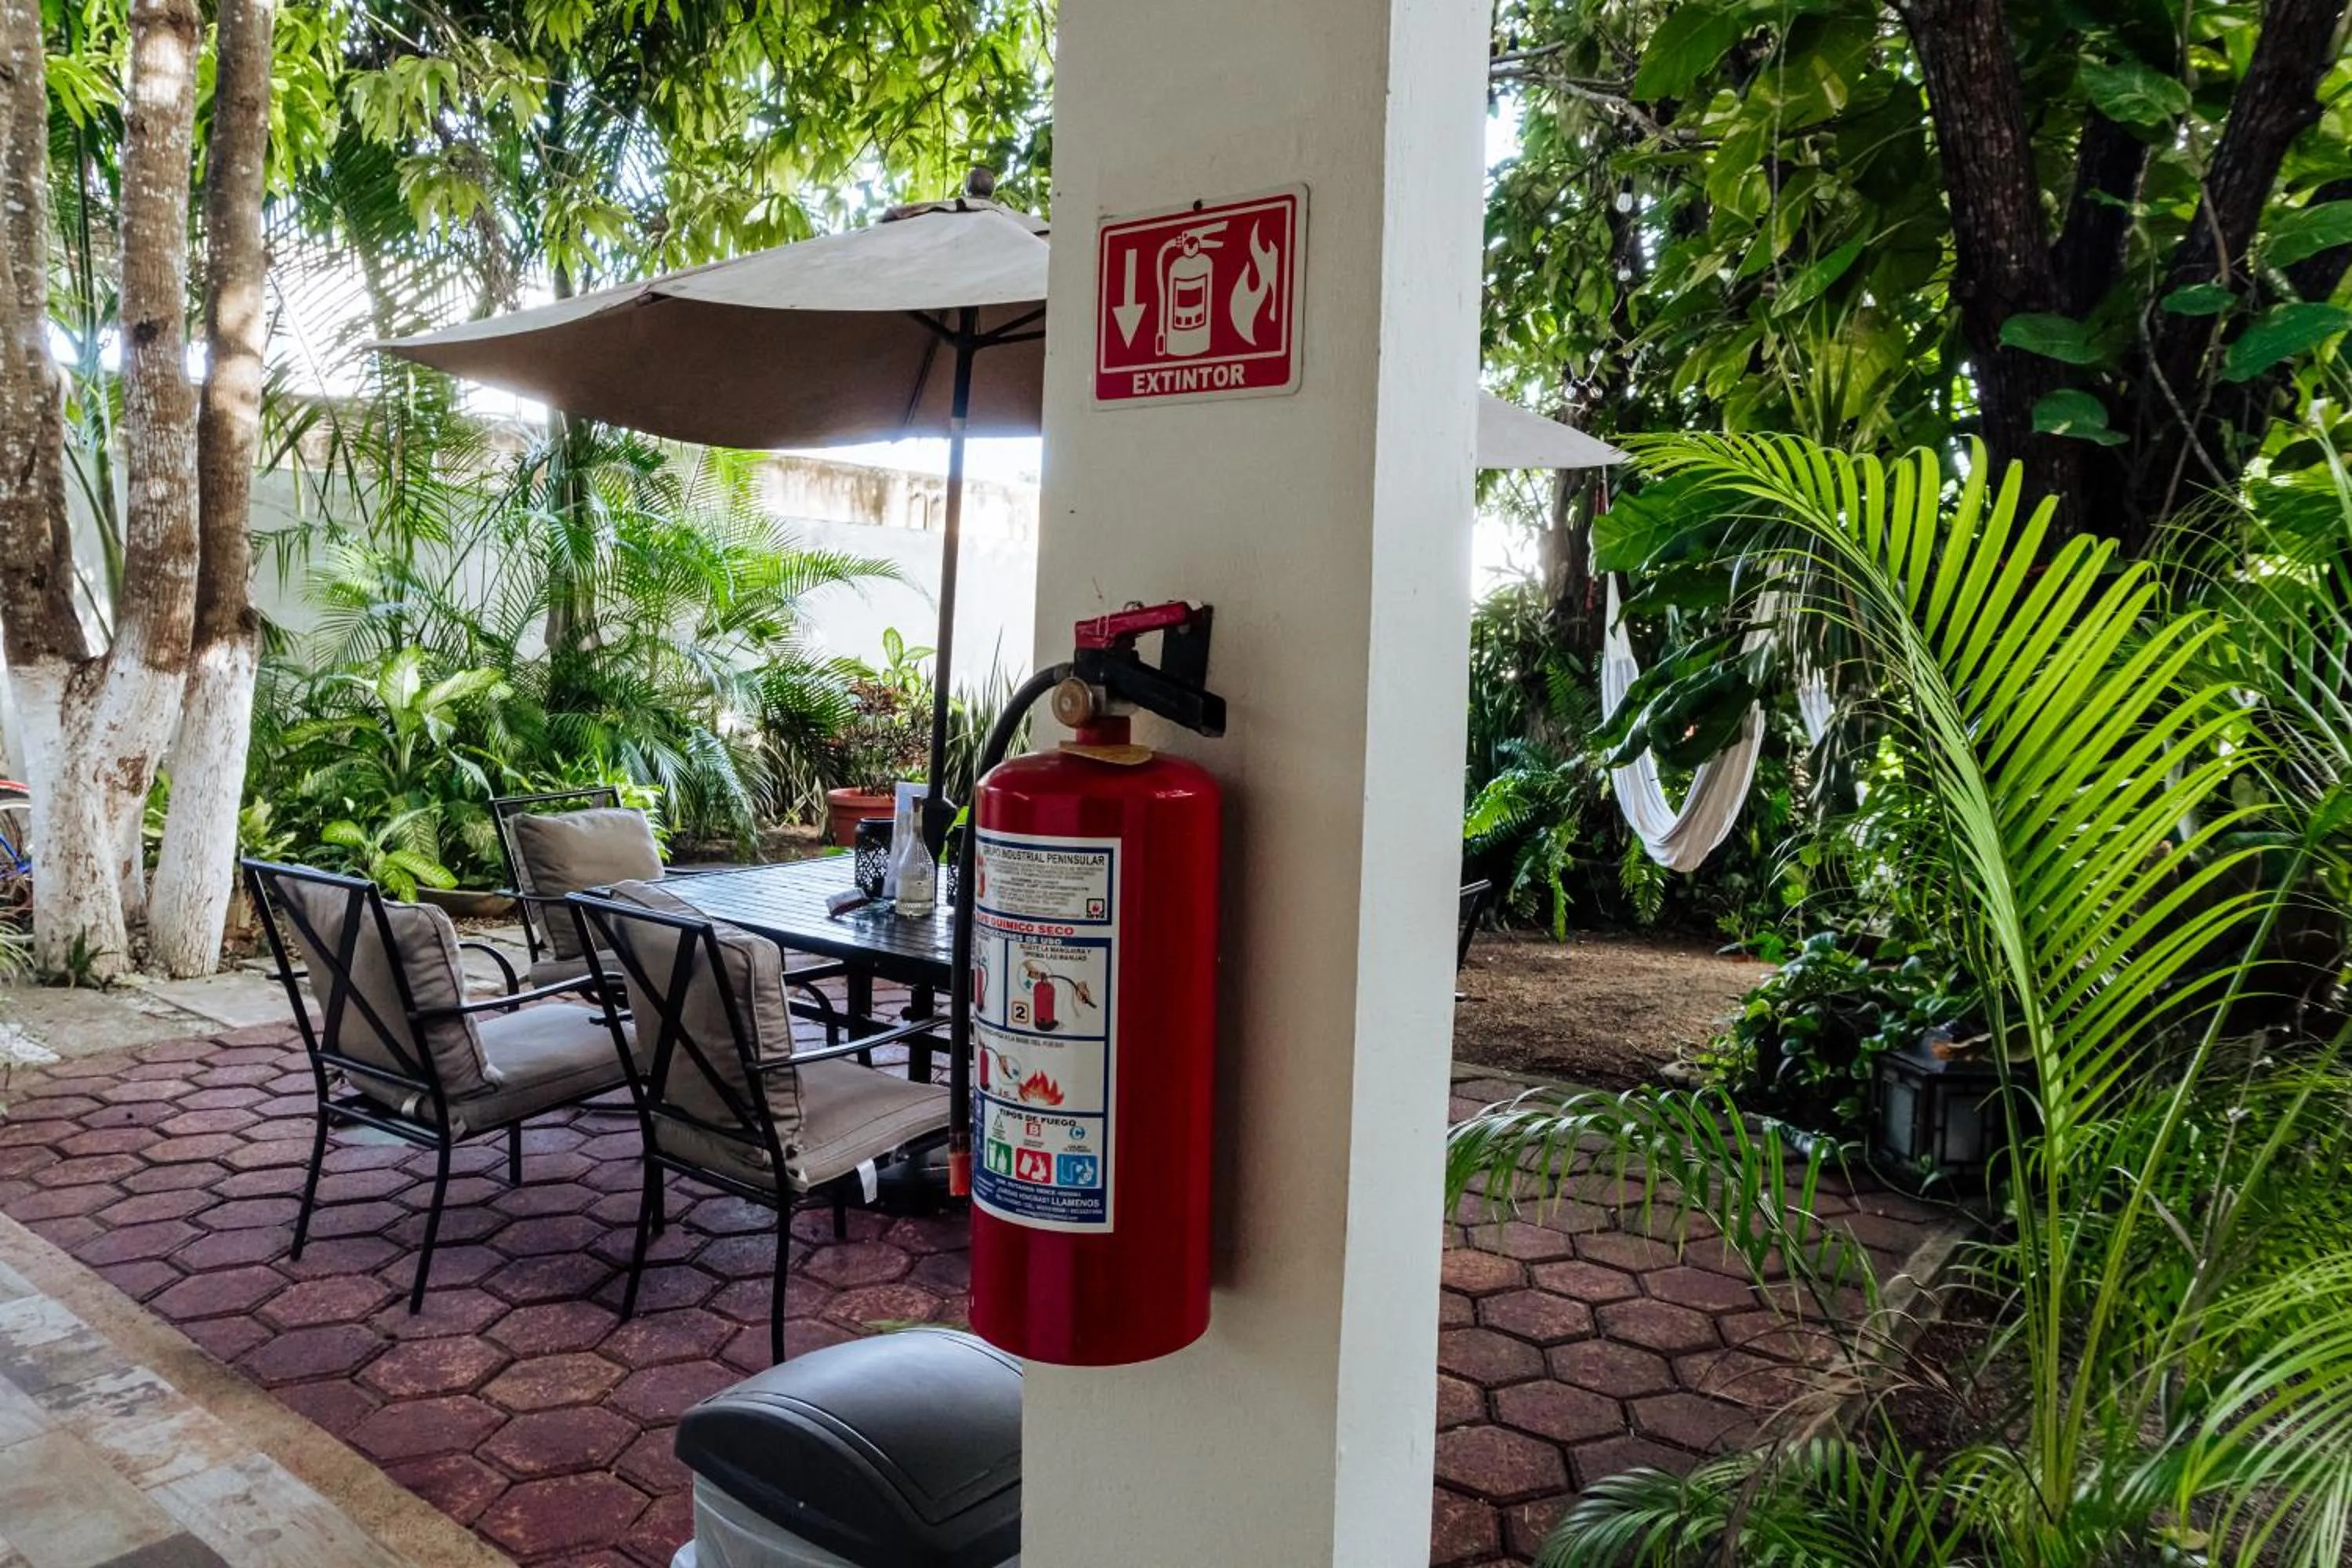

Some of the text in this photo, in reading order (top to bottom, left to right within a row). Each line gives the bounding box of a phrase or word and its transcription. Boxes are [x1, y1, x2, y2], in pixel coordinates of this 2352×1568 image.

[1132, 364, 1245, 394] EXTINTOR
[1003, 849, 1045, 863] INDUSTRIAL
[1047, 854, 1105, 866] PENINSULAR
[1038, 924, 1074, 935] SECO
[1015, 1007, 1025, 1019] 2
[999, 1109, 1076, 1127] TIPOS DE FUEGO
[1051, 1196, 1100, 1208] LLAMENOS
